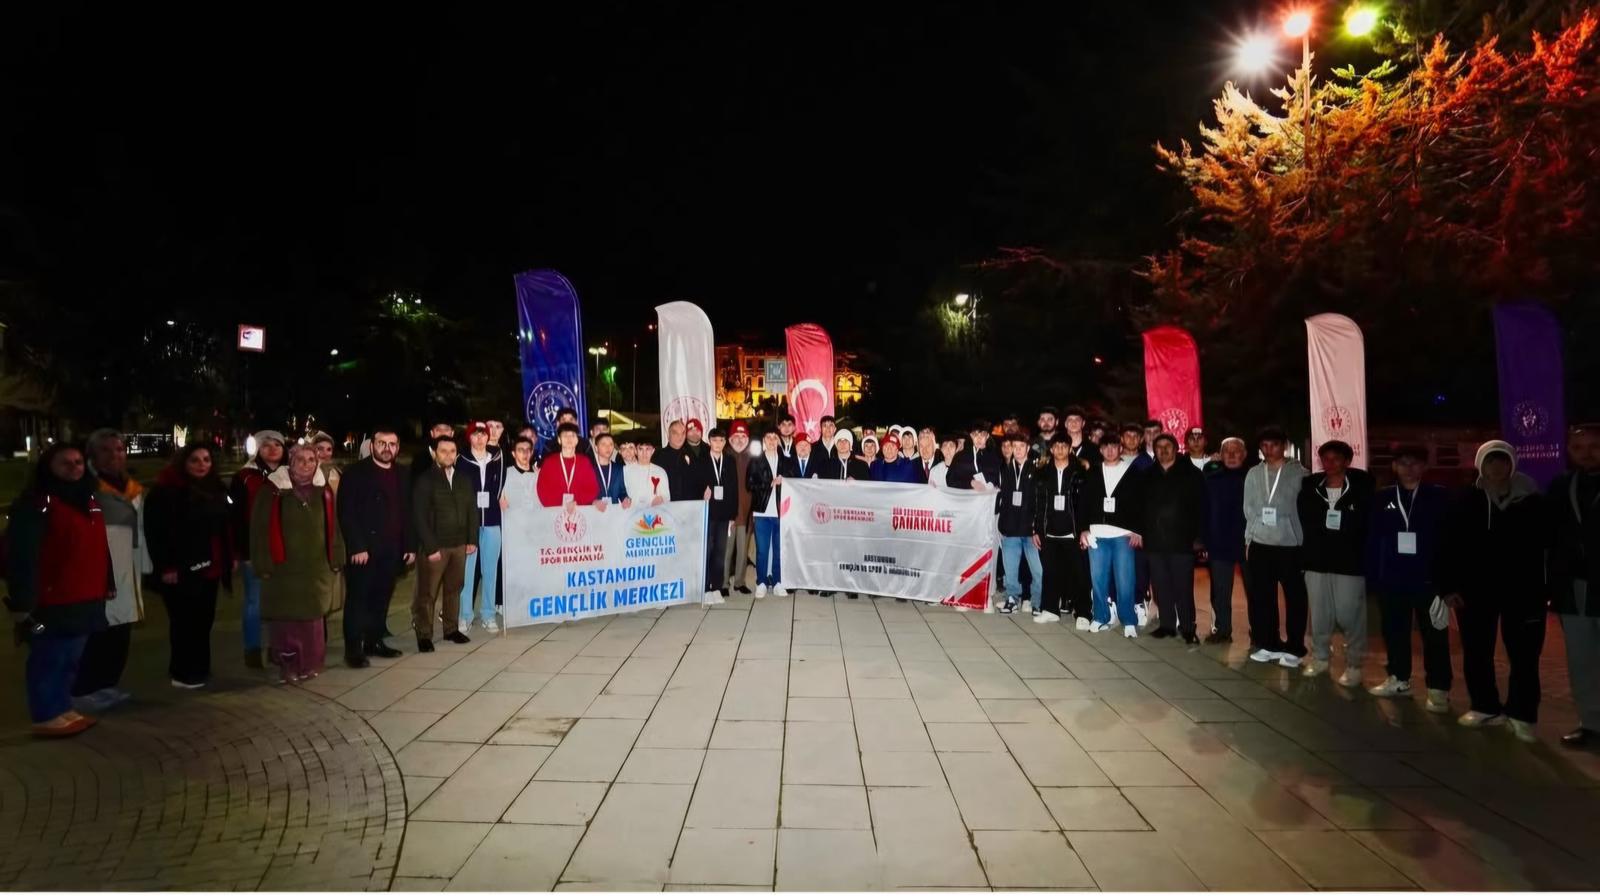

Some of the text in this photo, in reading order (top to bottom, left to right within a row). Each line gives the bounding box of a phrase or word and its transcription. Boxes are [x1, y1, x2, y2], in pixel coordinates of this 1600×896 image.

[892, 516, 952, 533] ÇANAKKALE
[567, 564, 656, 588] KASTAMONU
[529, 578, 685, 618] GENÇLİK MERKEZİ
